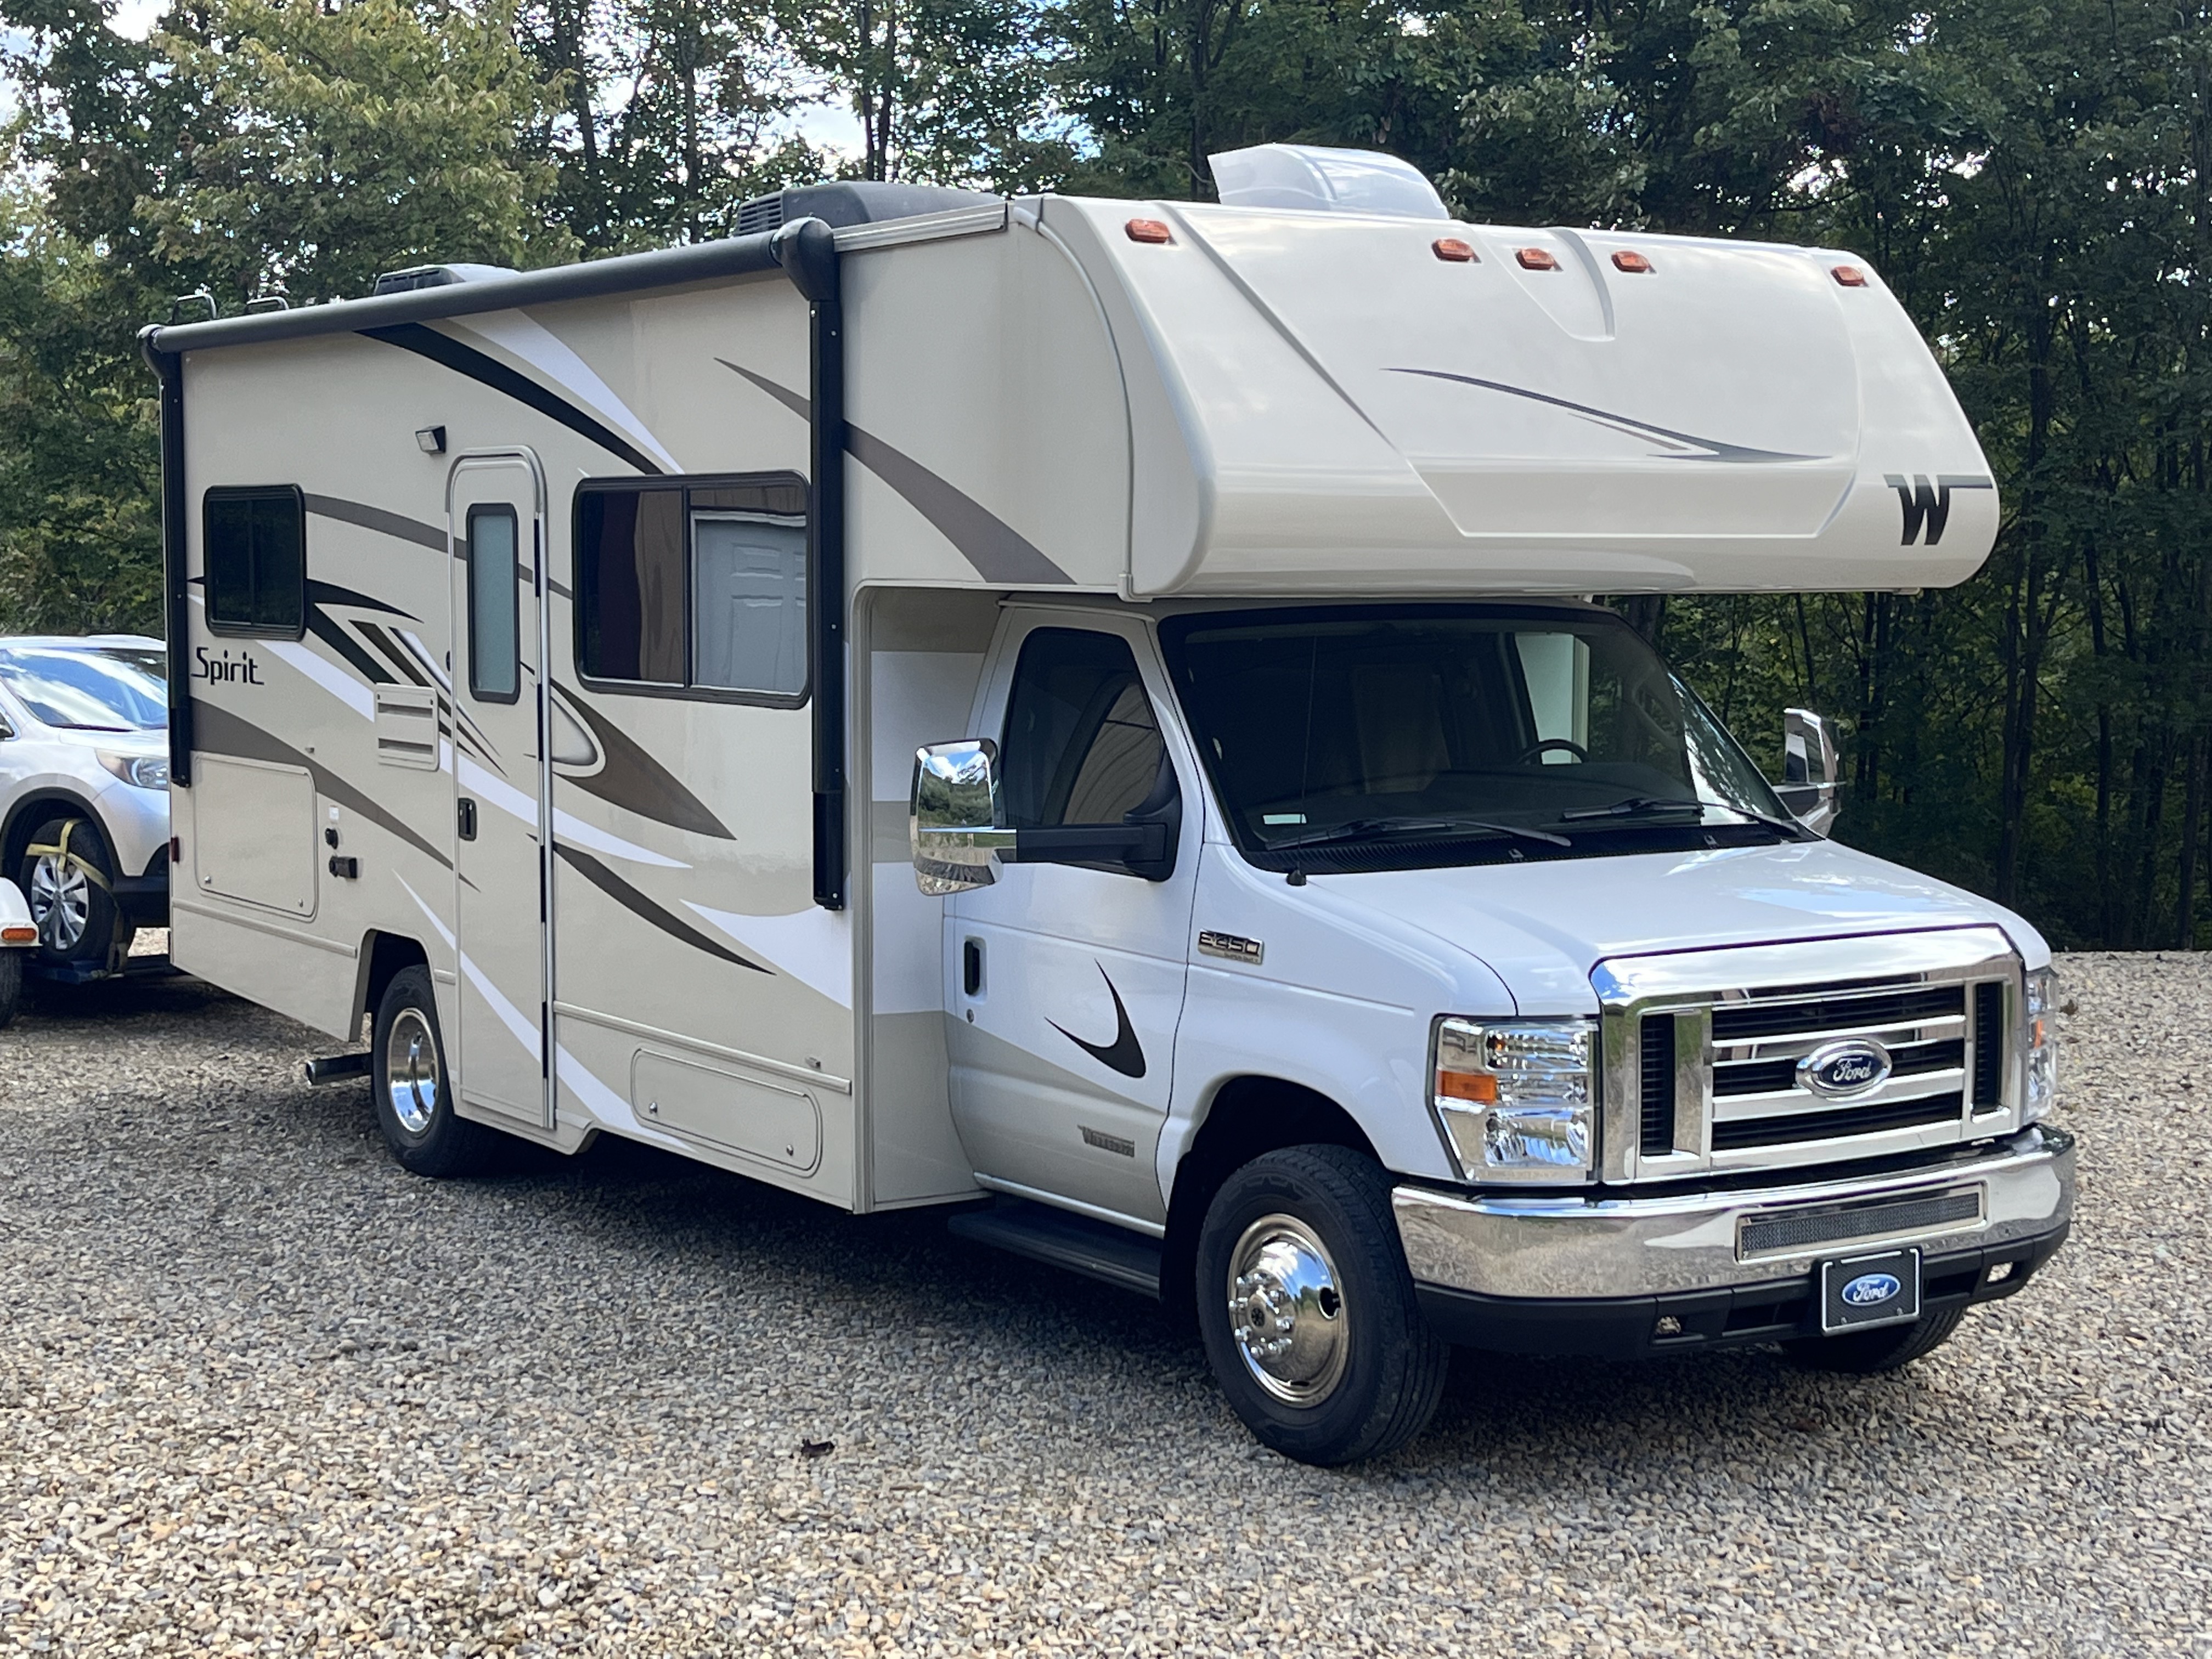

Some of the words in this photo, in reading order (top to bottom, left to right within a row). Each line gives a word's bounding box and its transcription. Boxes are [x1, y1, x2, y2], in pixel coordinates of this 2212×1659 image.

[190, 647, 264, 685] Spirit
[1832, 1057, 1872, 1082] Ford
[1852, 1278, 1889, 1302] Ford
